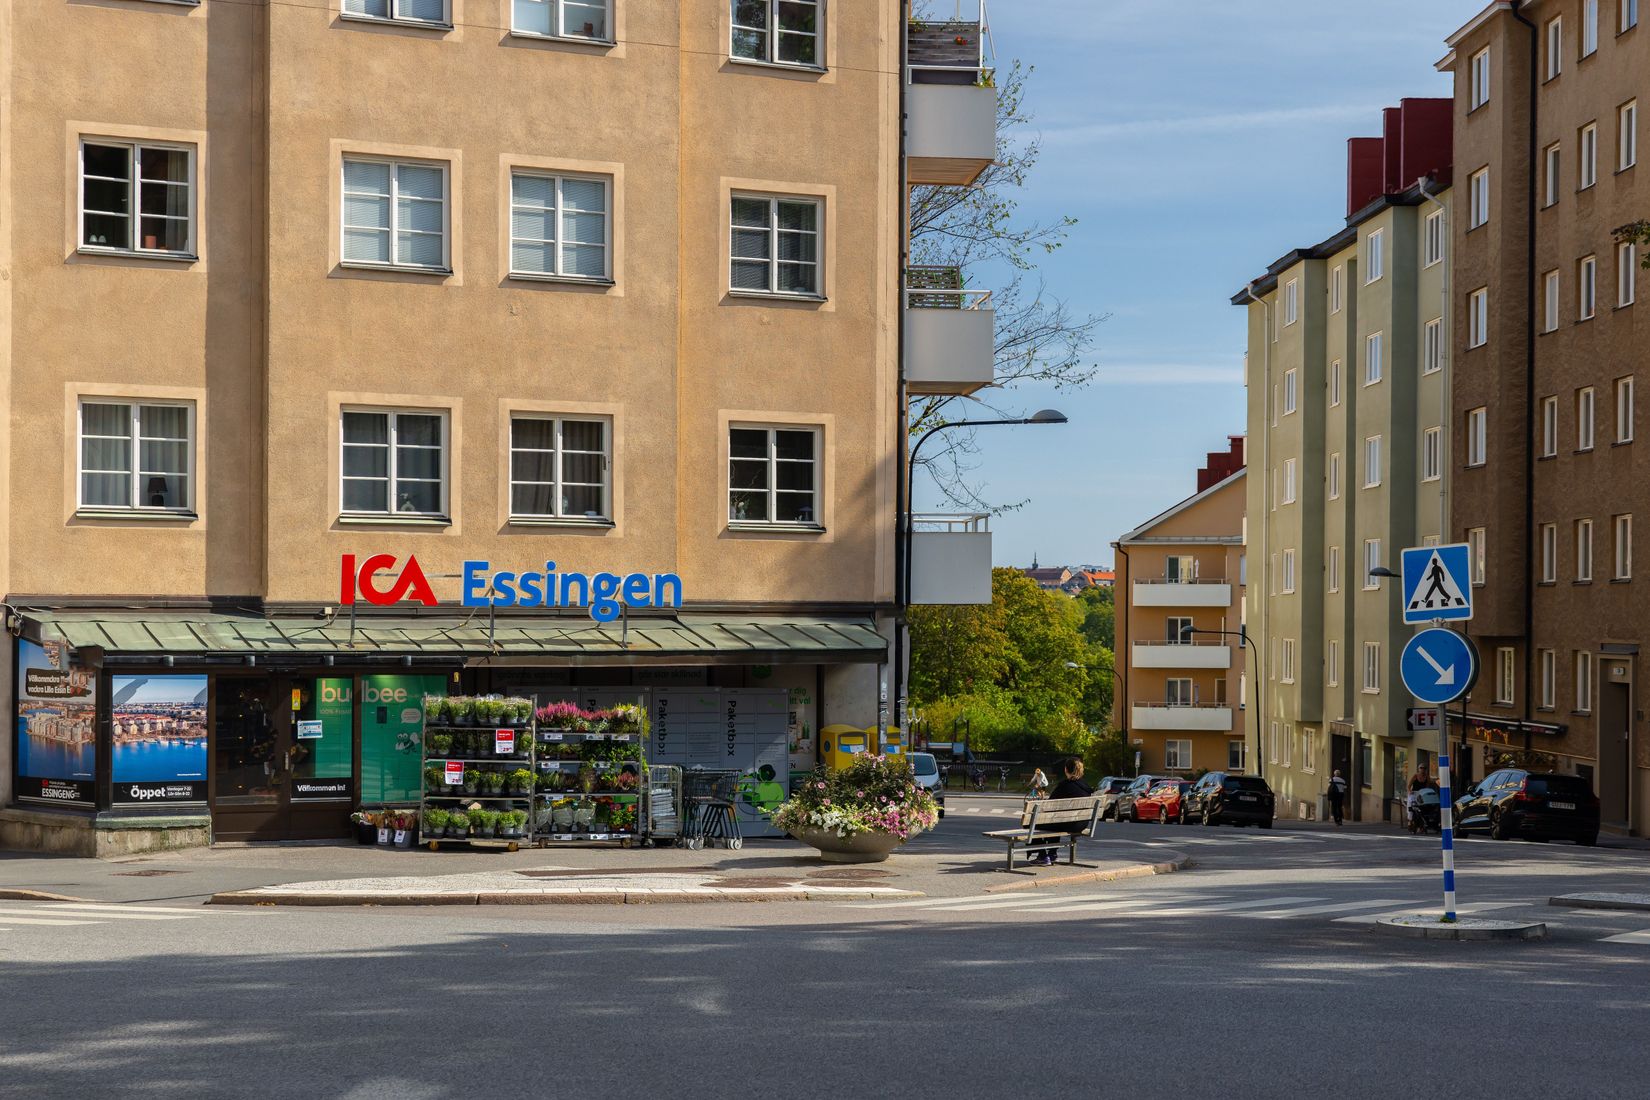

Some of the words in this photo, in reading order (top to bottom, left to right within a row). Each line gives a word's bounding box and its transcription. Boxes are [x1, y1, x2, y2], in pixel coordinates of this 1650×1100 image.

[340, 553, 439, 606] ICA
[461, 560, 683, 623] Essingen
[658, 699, 669, 756] Paketbox
[727, 700, 737, 757] Paketbox
[130, 784, 166, 800] Öppet
[296, 784, 337, 792] Välkommen
